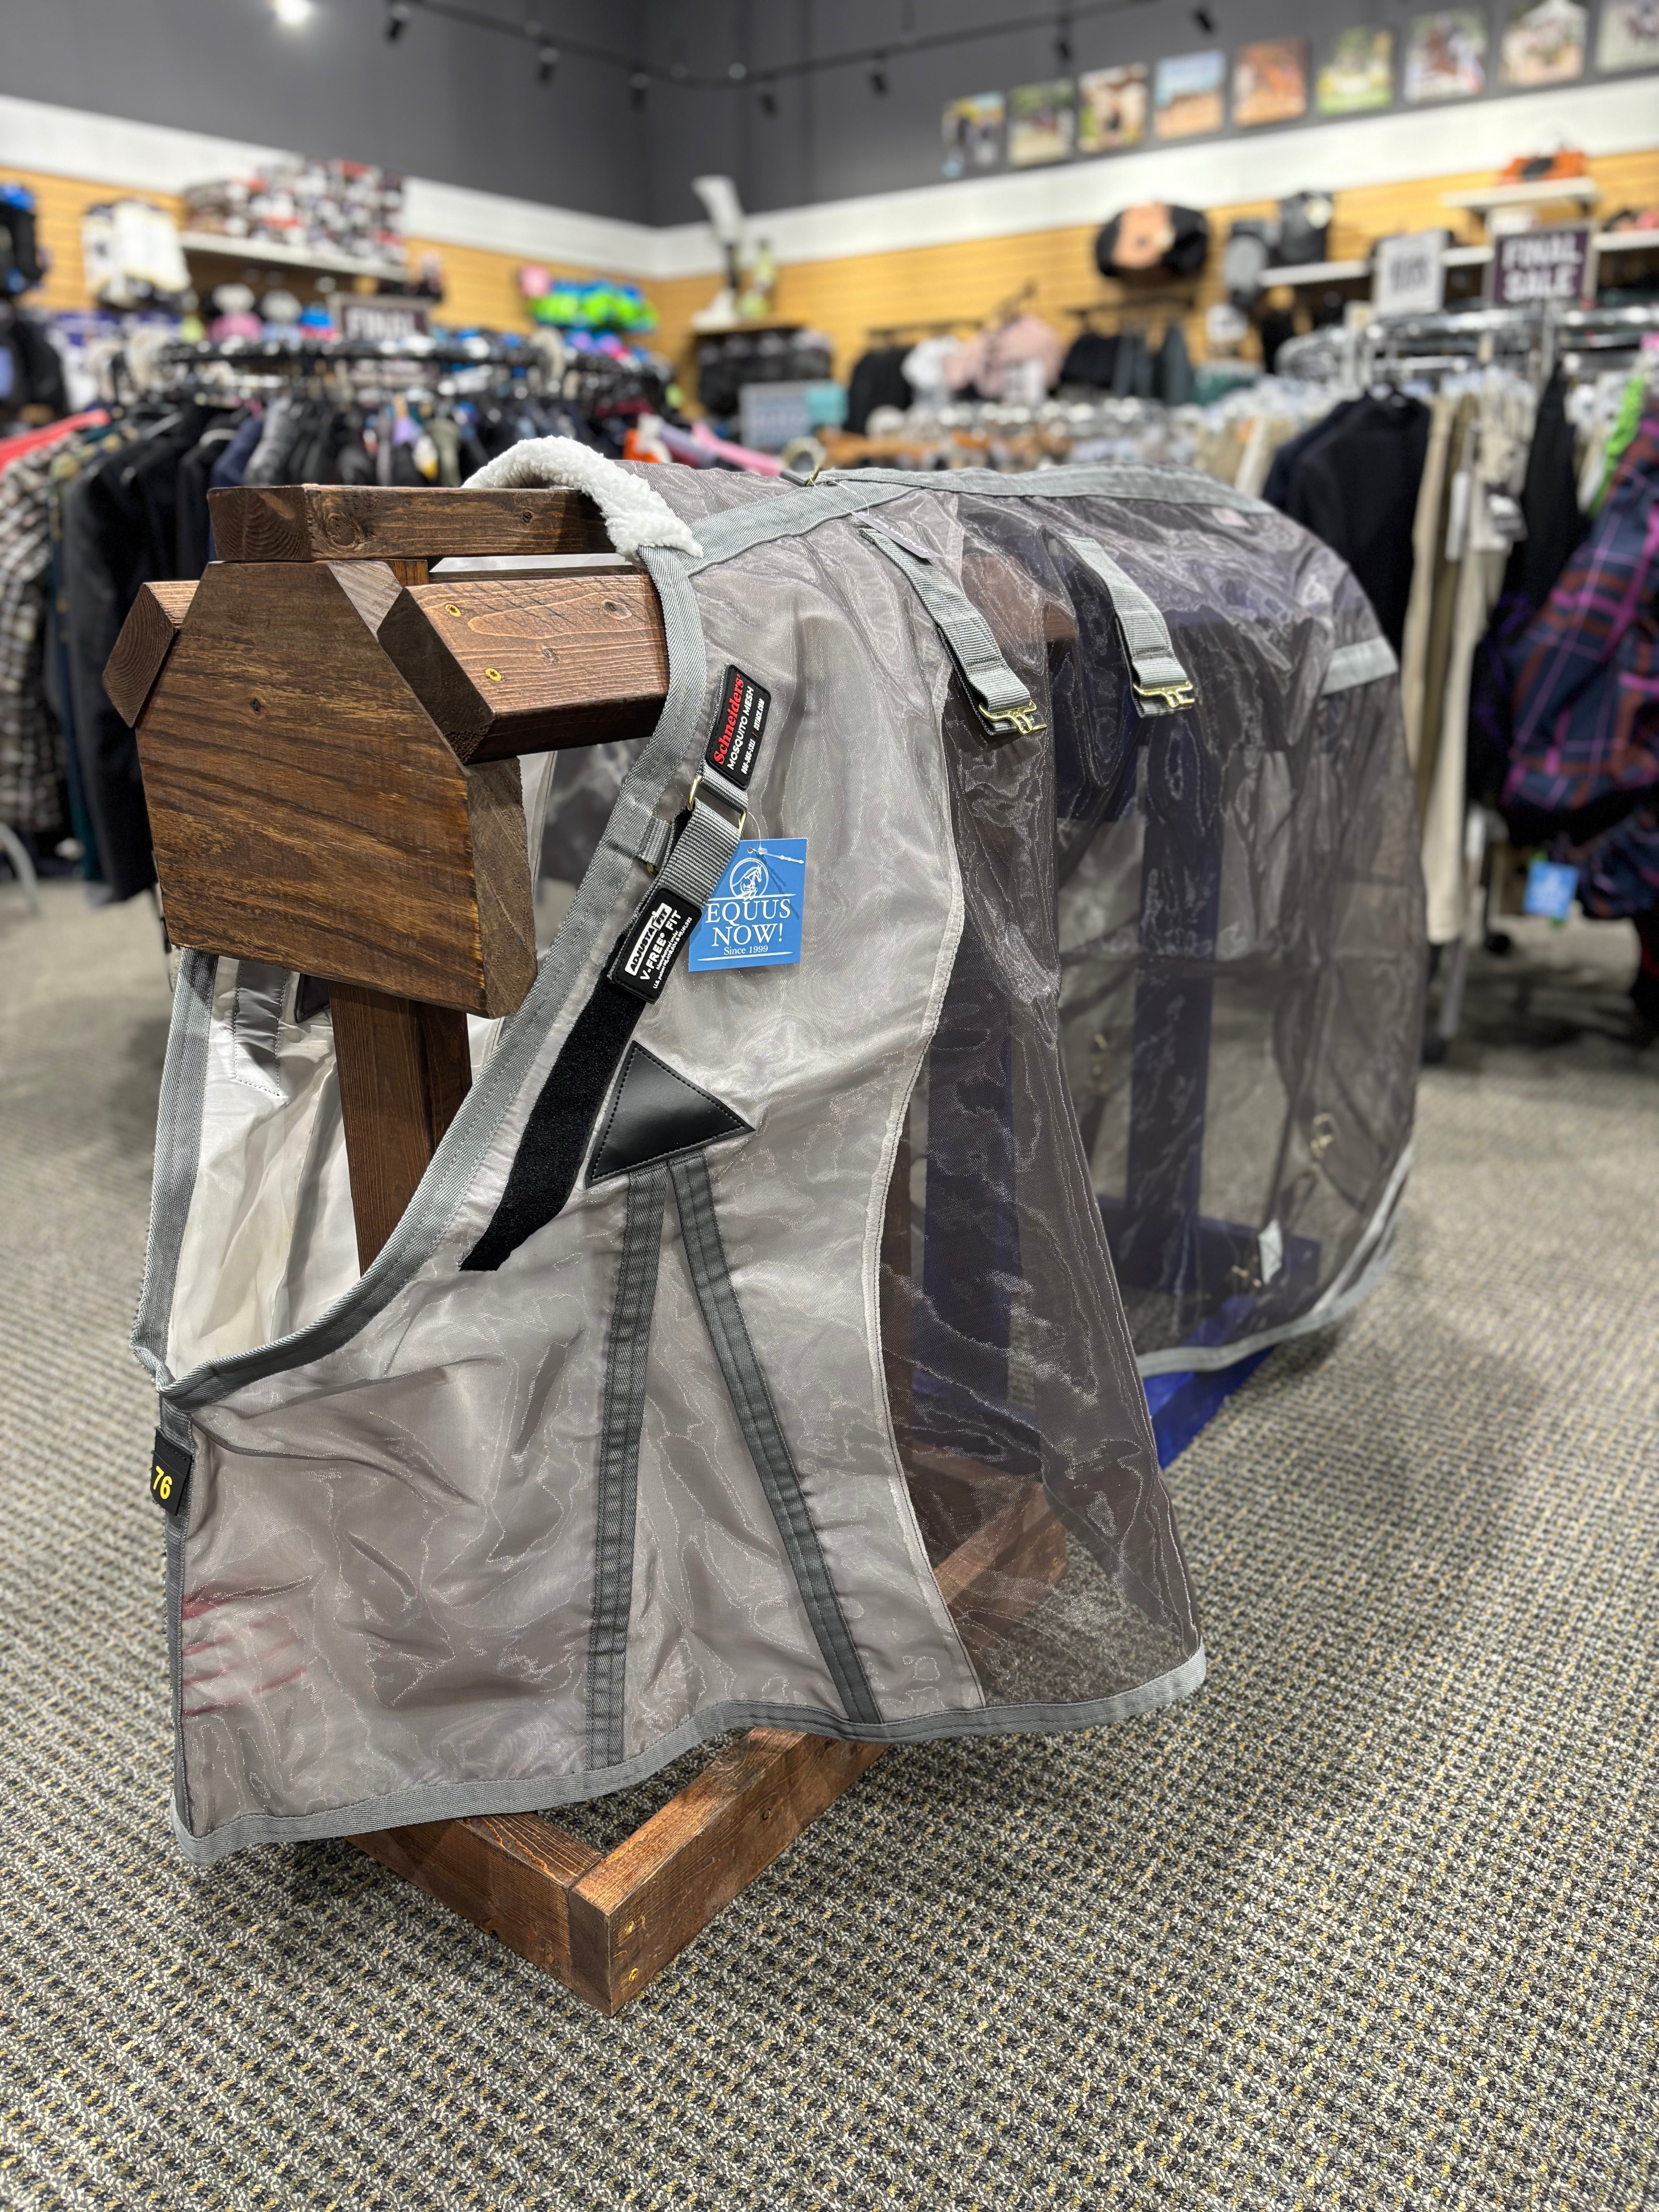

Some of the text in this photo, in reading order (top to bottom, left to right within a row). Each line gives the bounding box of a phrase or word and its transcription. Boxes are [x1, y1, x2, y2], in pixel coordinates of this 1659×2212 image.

[1502, 232, 1583, 270] FINAL
[1503, 264, 1577, 302] SALE
[346, 307, 420, 341] FINAL
[727, 686, 754, 770] MOSQUITO MESH
[754, 698, 765, 731] SSTACK.COM
[665, 910, 681, 931] FIT
[705, 898, 791, 927] EQUUS
[656, 930, 678, 970] Manufactured under
[712, 923, 783, 947] NOW!
[724, 945, 768, 955] Since 1999
[153, 1466, 172, 1499] 76
